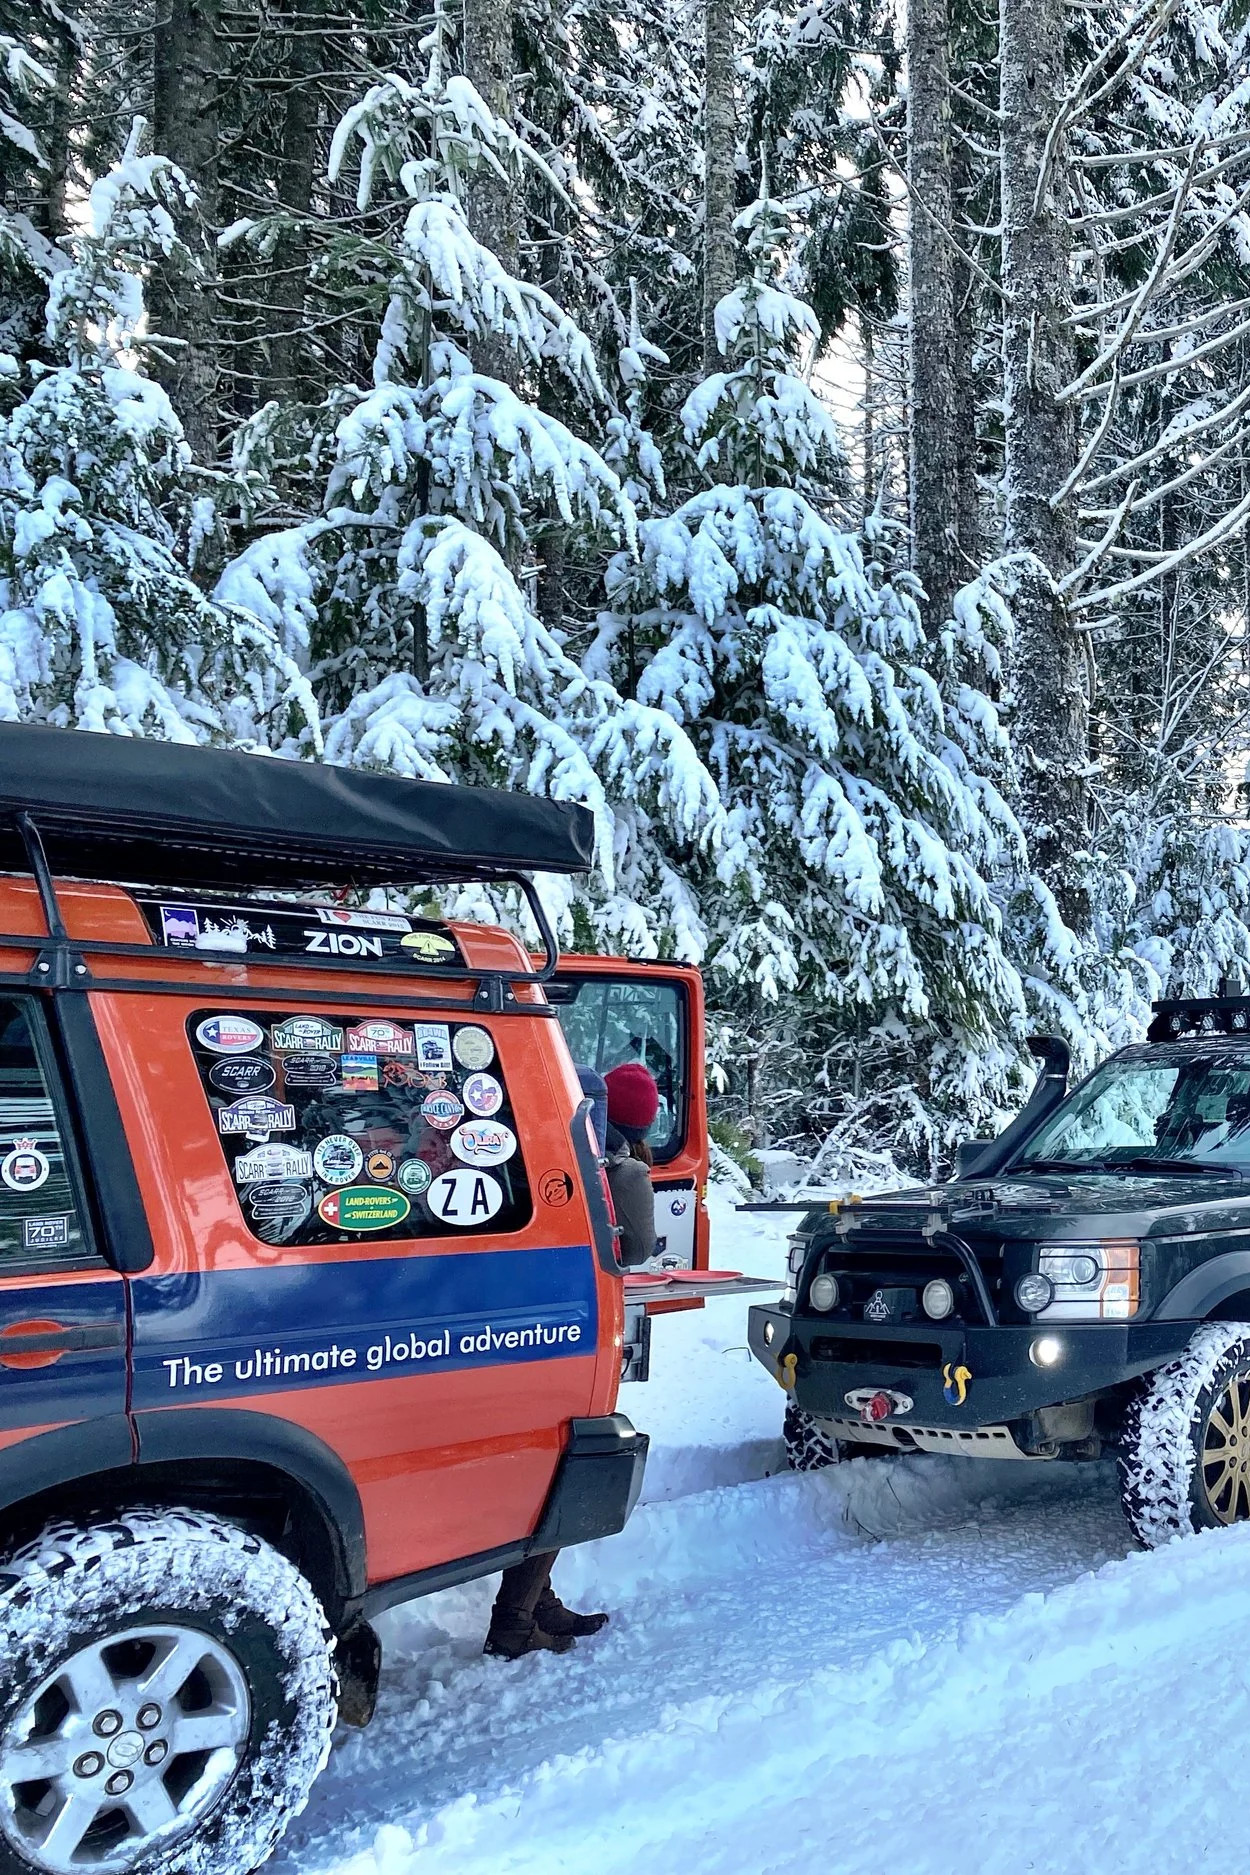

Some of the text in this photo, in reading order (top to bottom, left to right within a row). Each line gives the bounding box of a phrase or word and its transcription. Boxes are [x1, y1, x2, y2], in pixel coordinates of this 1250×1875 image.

[303, 930, 383, 957] ZION
[273, 1030, 304, 1049] SCARR
[314, 1032, 342, 1051] RALLY
[348, 1033, 413, 1054] SCARR RALLY
[289, 1056, 315, 1064] SCARR
[221, 1065, 262, 1077] SCARR
[221, 1108, 293, 1131] SCARR RALLY
[324, 1136, 347, 1146] NEVER
[347, 1140, 362, 1157] OVER
[238, 1155, 309, 1180] SCARR RALLY
[334, 1171, 356, 1183] ROVER
[345, 1196, 392, 1206] LAND-ROVERS
[351, 1209, 398, 1220] SWITZERLAND
[162, 1322, 582, 1388] The ultimate global adventure
